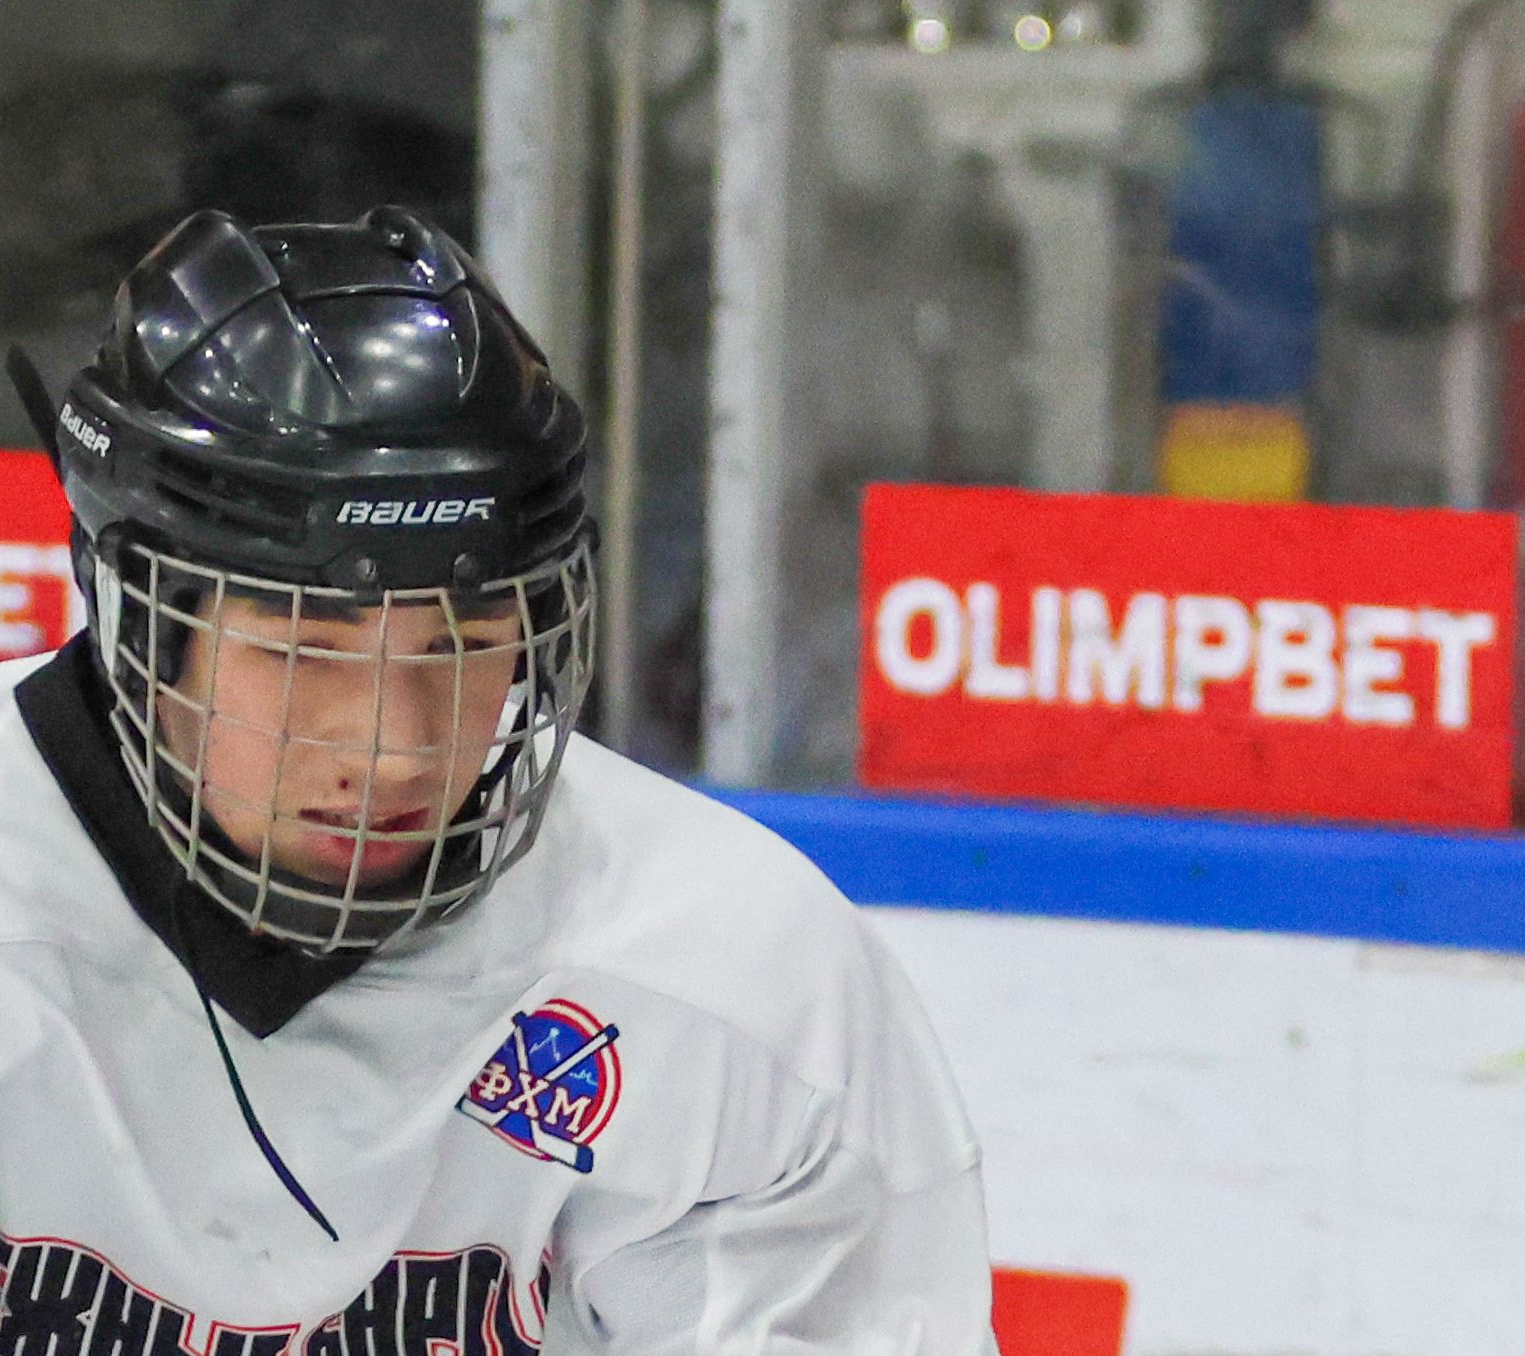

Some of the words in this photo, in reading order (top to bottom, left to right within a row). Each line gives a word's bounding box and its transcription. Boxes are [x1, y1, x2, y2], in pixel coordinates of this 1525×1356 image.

[61, 403, 111, 457] BAUER
[338, 497, 495, 524] BAUER
[875, 577, 1496, 730] OLIMPBET
[474, 1060, 592, 1134] ФХМ
